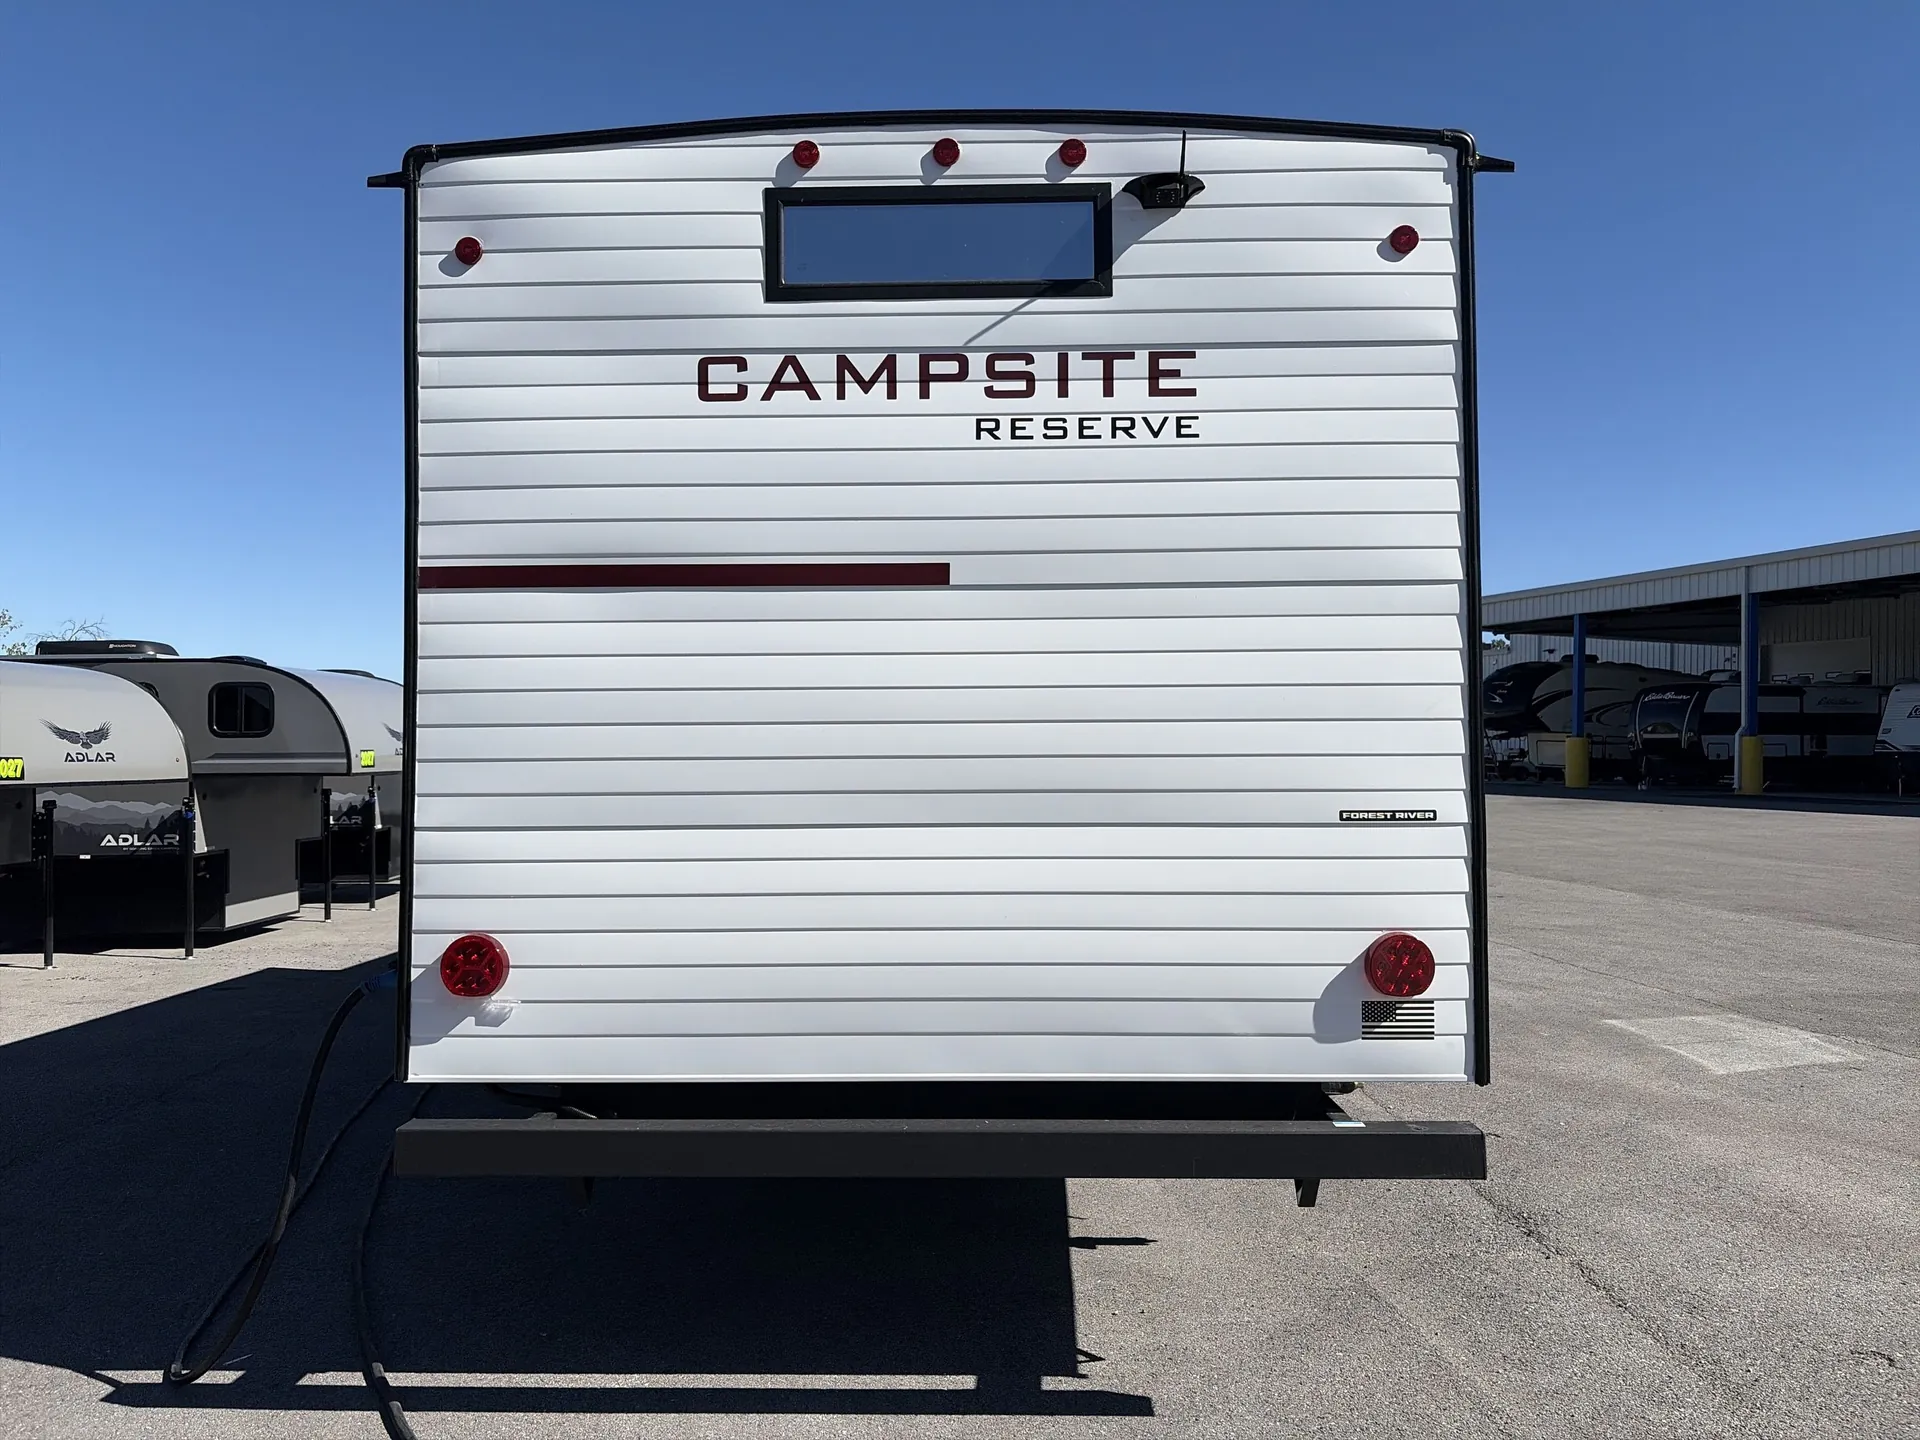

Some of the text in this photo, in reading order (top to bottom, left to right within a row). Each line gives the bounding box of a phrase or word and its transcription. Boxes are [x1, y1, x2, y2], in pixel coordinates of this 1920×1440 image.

[697, 351, 1197, 402] CAMPSITE
[975, 415, 1200, 440] RESERVE
[64, 752, 116, 762] ADLAR
[0, 758, 23, 778] 027
[329, 815, 362, 824] LAR
[100, 834, 180, 846] ADLAR
